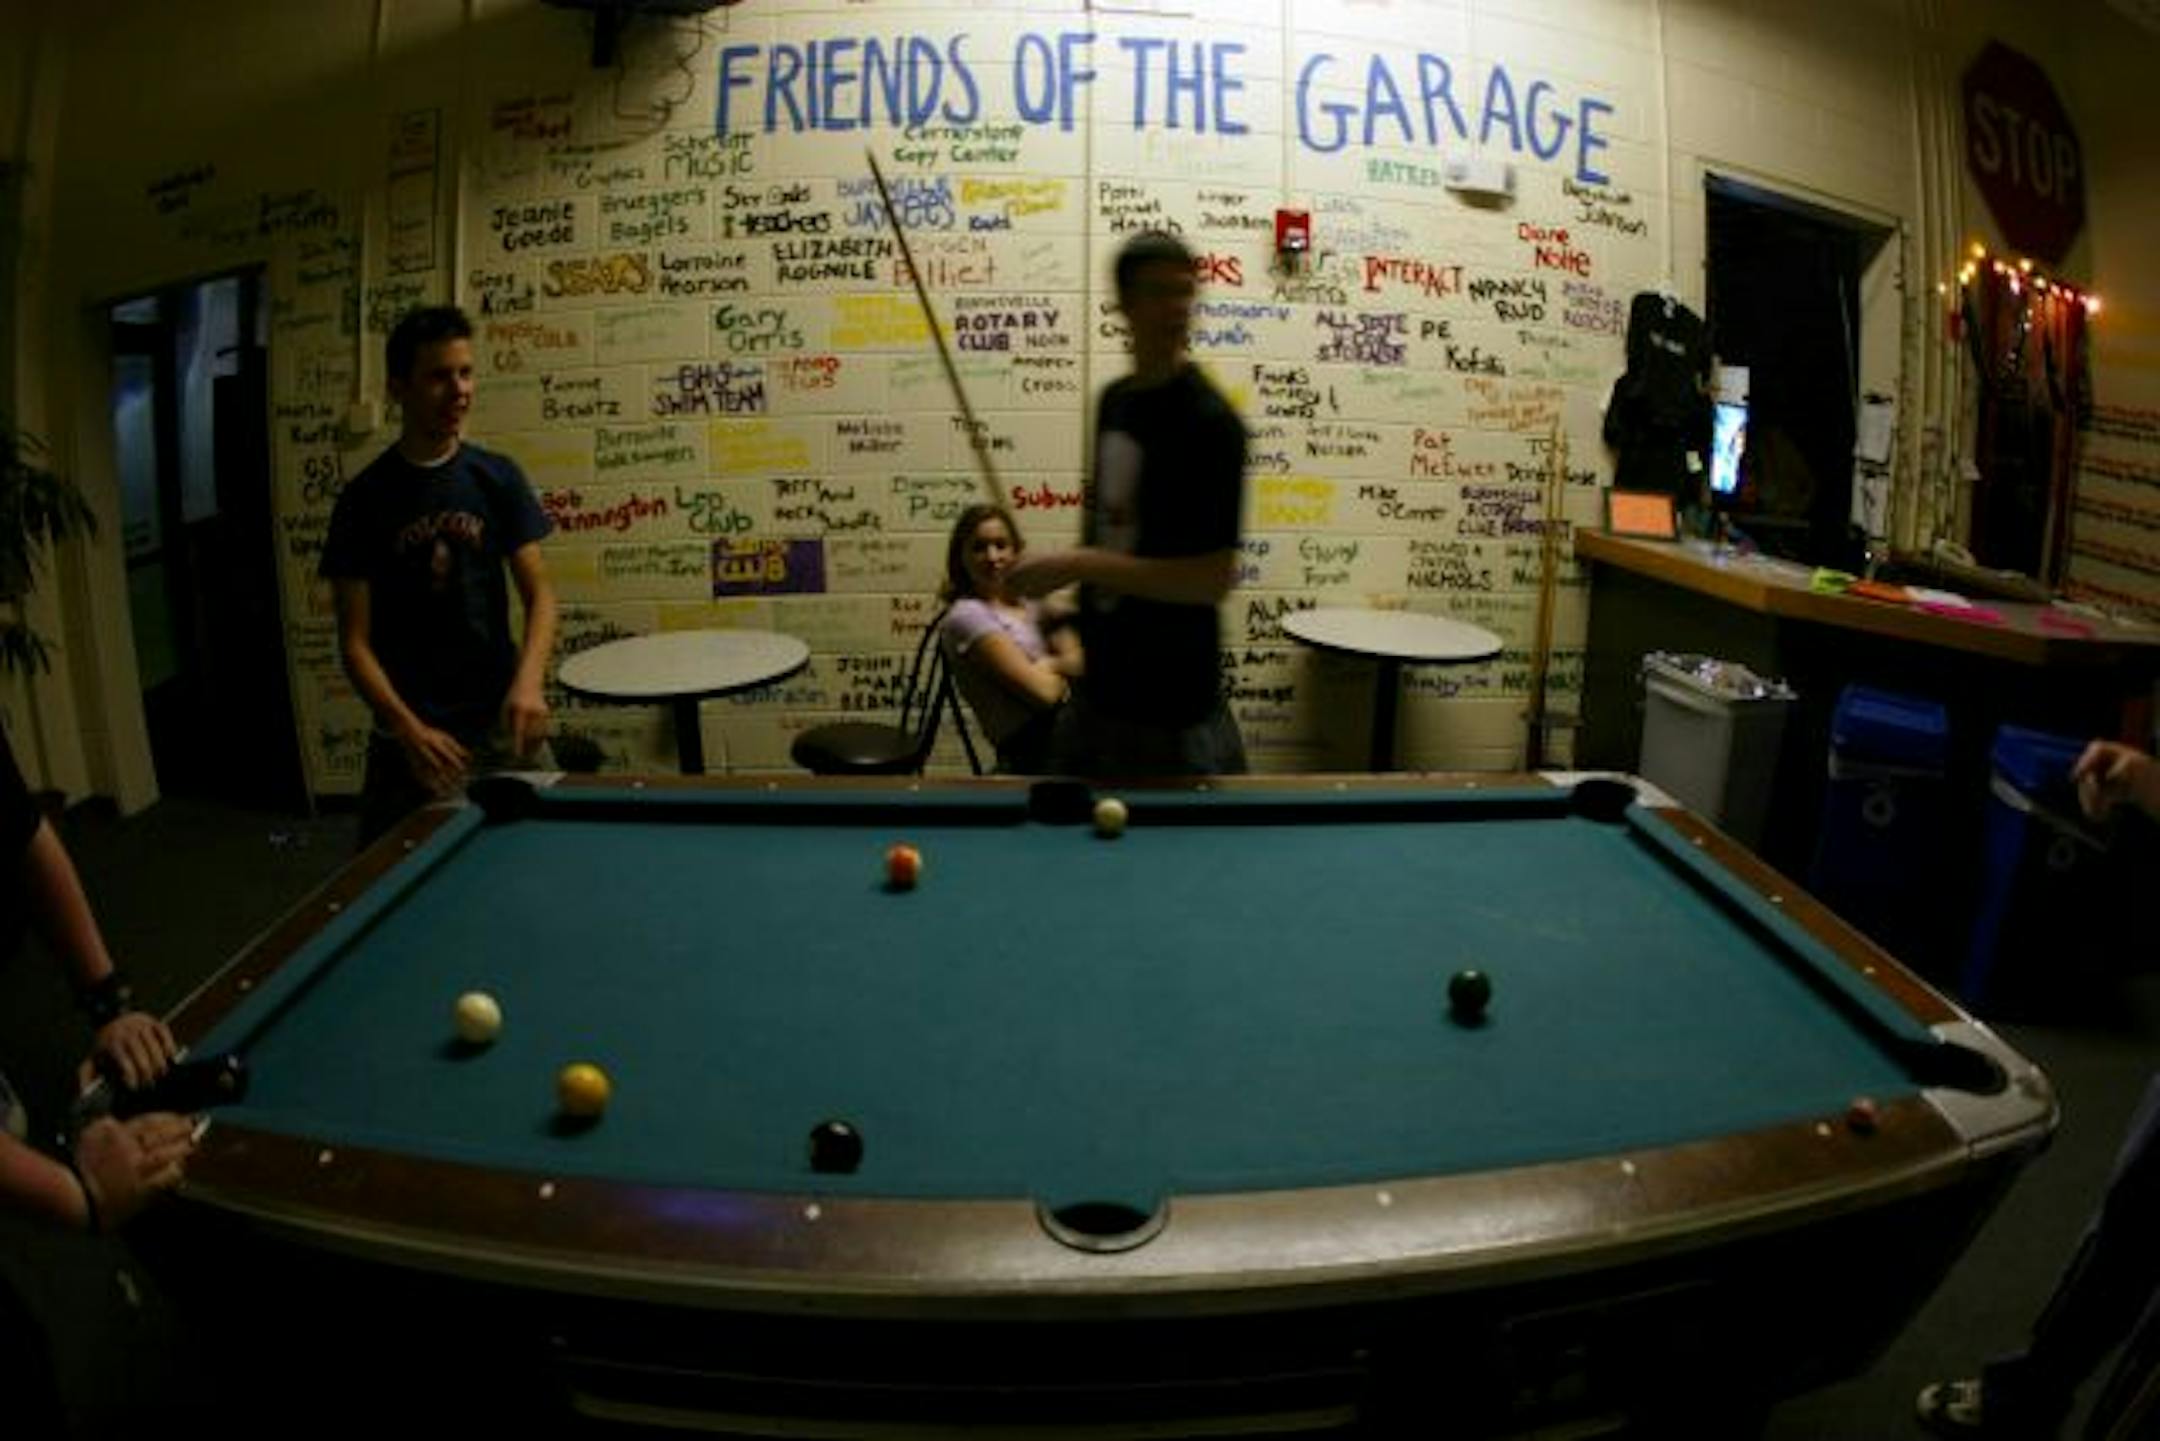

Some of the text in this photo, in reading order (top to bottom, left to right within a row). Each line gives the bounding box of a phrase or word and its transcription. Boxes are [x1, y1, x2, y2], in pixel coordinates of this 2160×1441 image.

[715, 30, 1615, 186] FRIENDS OF THE GARAGE
[1973, 91, 2077, 205] STOP
[660, 252, 746, 274] Lorraine
[773, 238, 892, 262] ELIZABETH
[1364, 256, 1465, 298] INTERACT
[716, 303, 787, 332] Gary
[955, 311, 1060, 333] ROTARY
[958, 333, 1010, 352] CLUB
[1412, 428, 1451, 450] Pat
[1011, 480, 1082, 510] Subw
